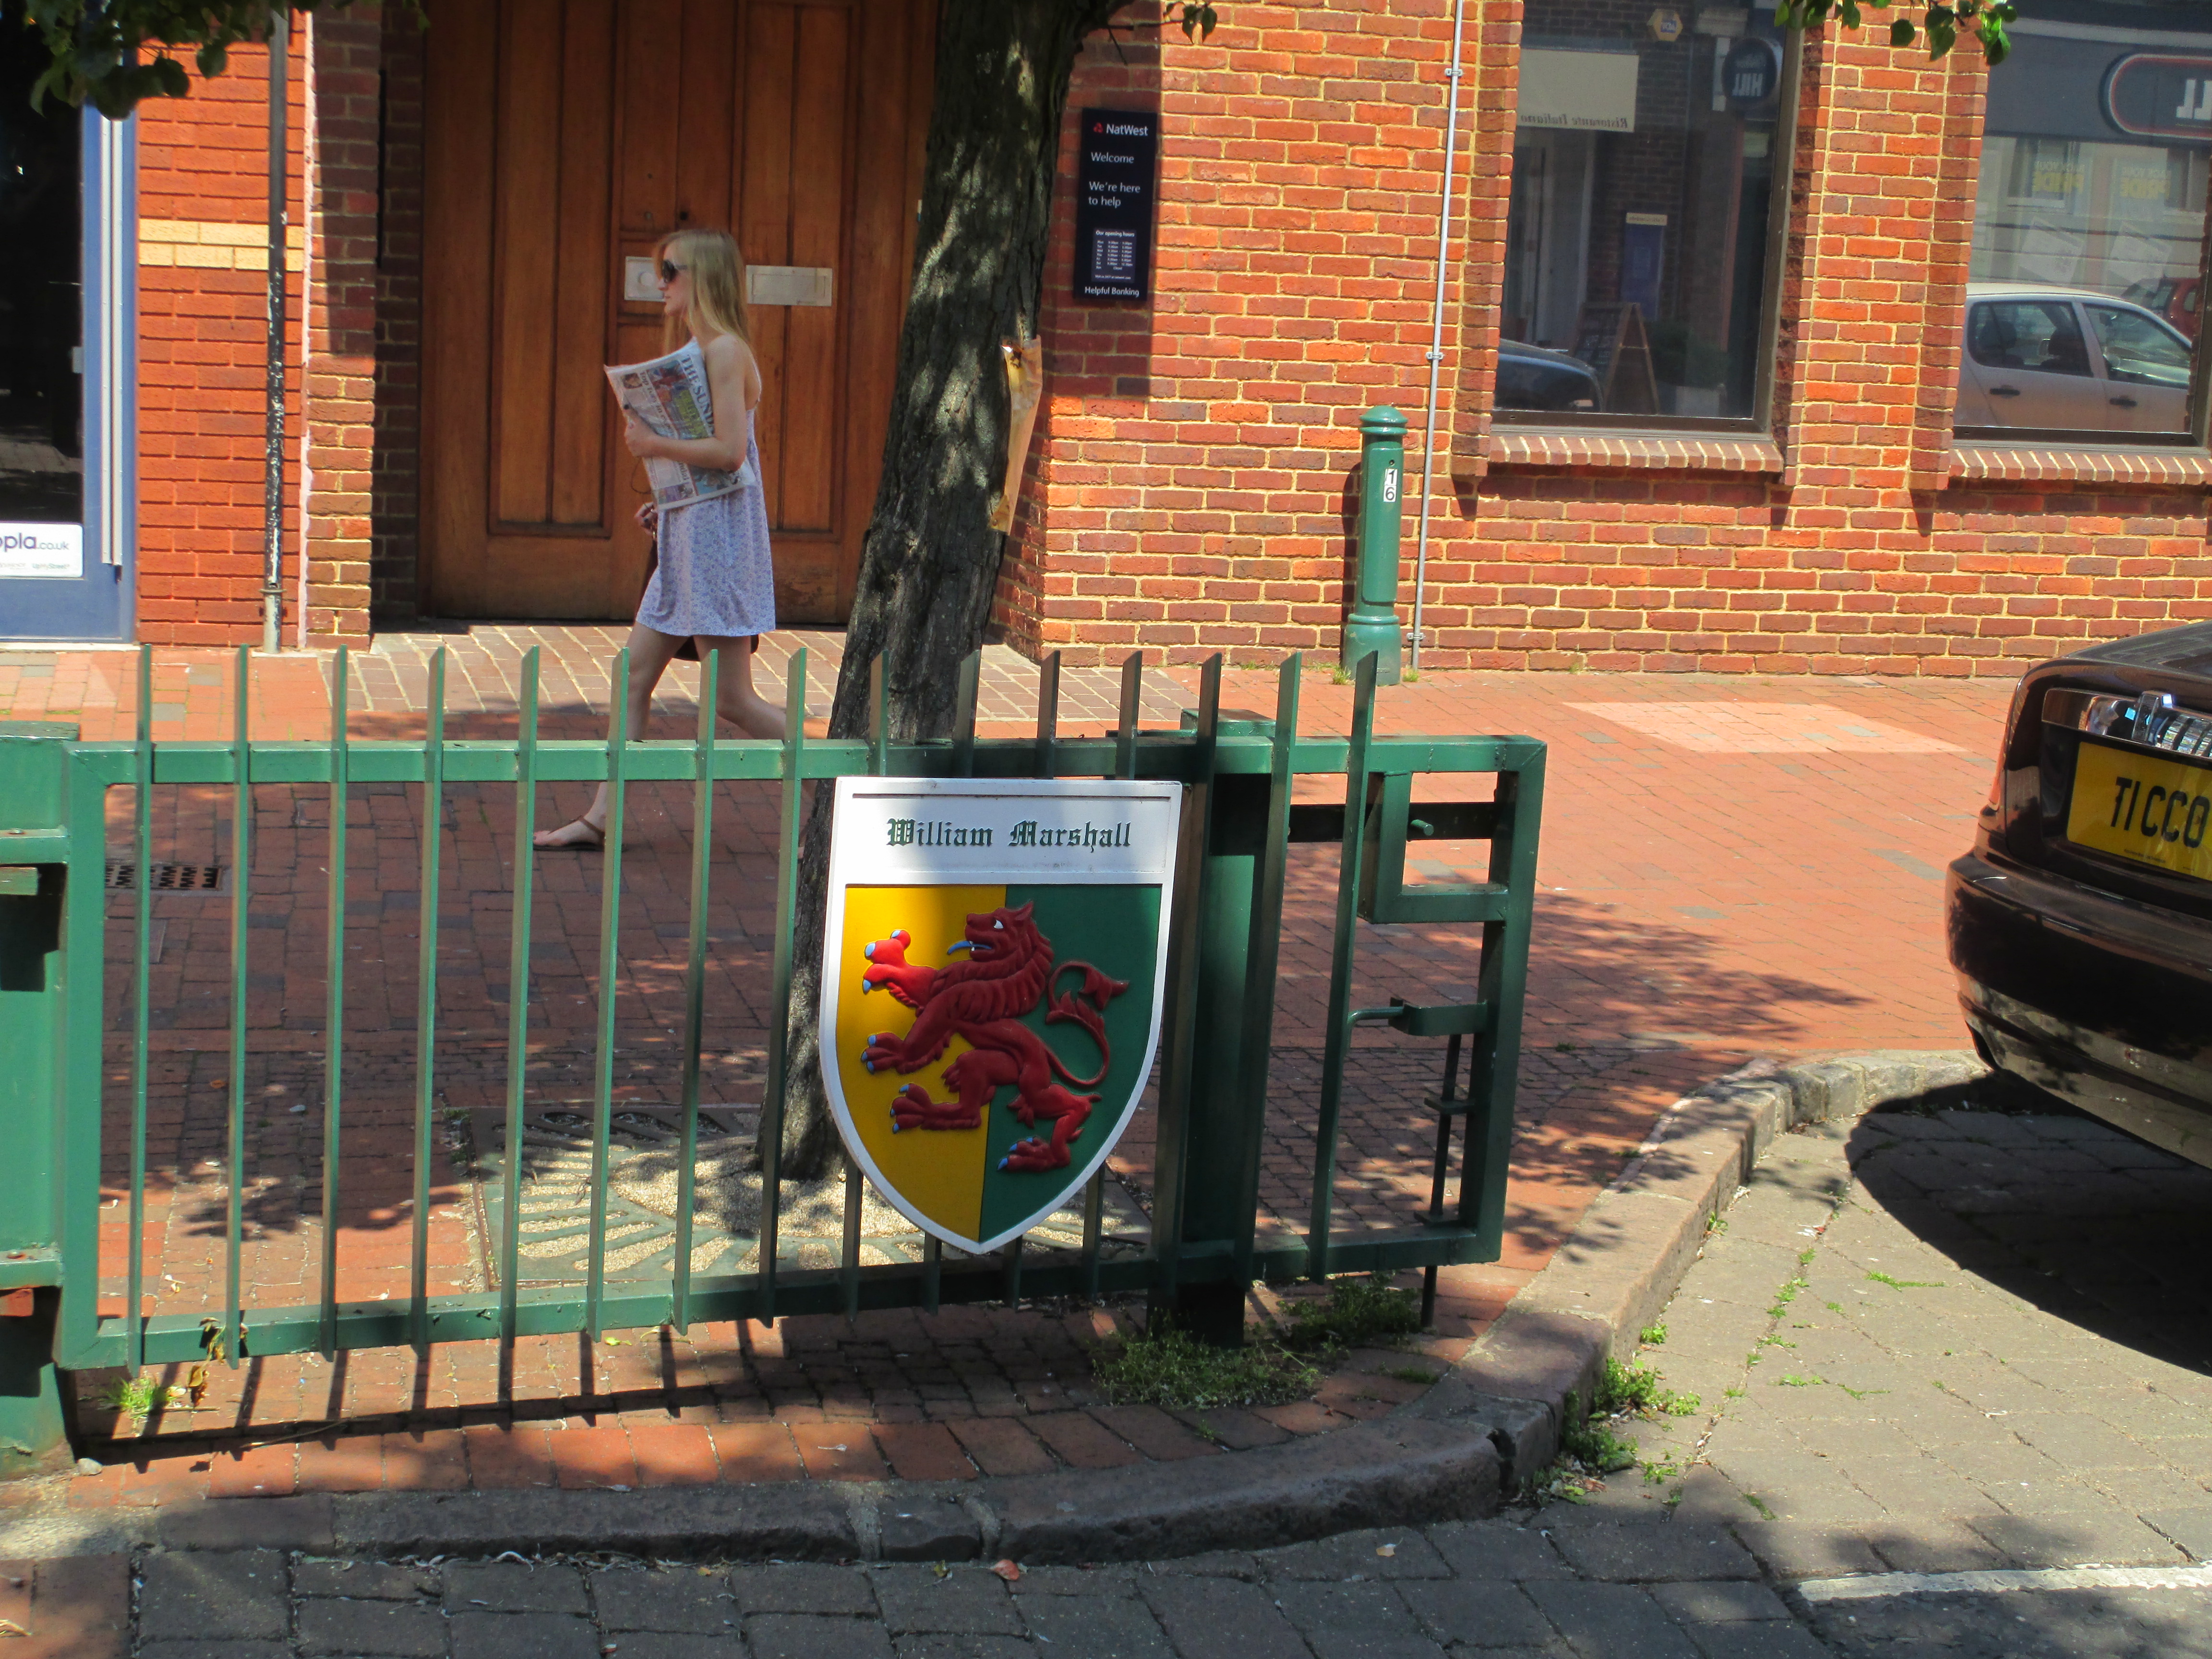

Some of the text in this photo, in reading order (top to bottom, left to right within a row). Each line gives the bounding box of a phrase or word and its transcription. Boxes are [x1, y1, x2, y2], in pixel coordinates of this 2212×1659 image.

[1106, 123, 1148, 136] NatWest
[1091, 152, 1134, 163] Welcome
[1089, 181, 1141, 193] We're here
[1088, 197, 1121, 208] to help
[1085, 286, 1140, 298] Helpful Banking
[681, 354, 700, 383] THE
[693, 385, 715, 435] SUNDA
[0, 532, 70, 553] pla.co.uk
[887, 817, 1132, 854] William Marshall
